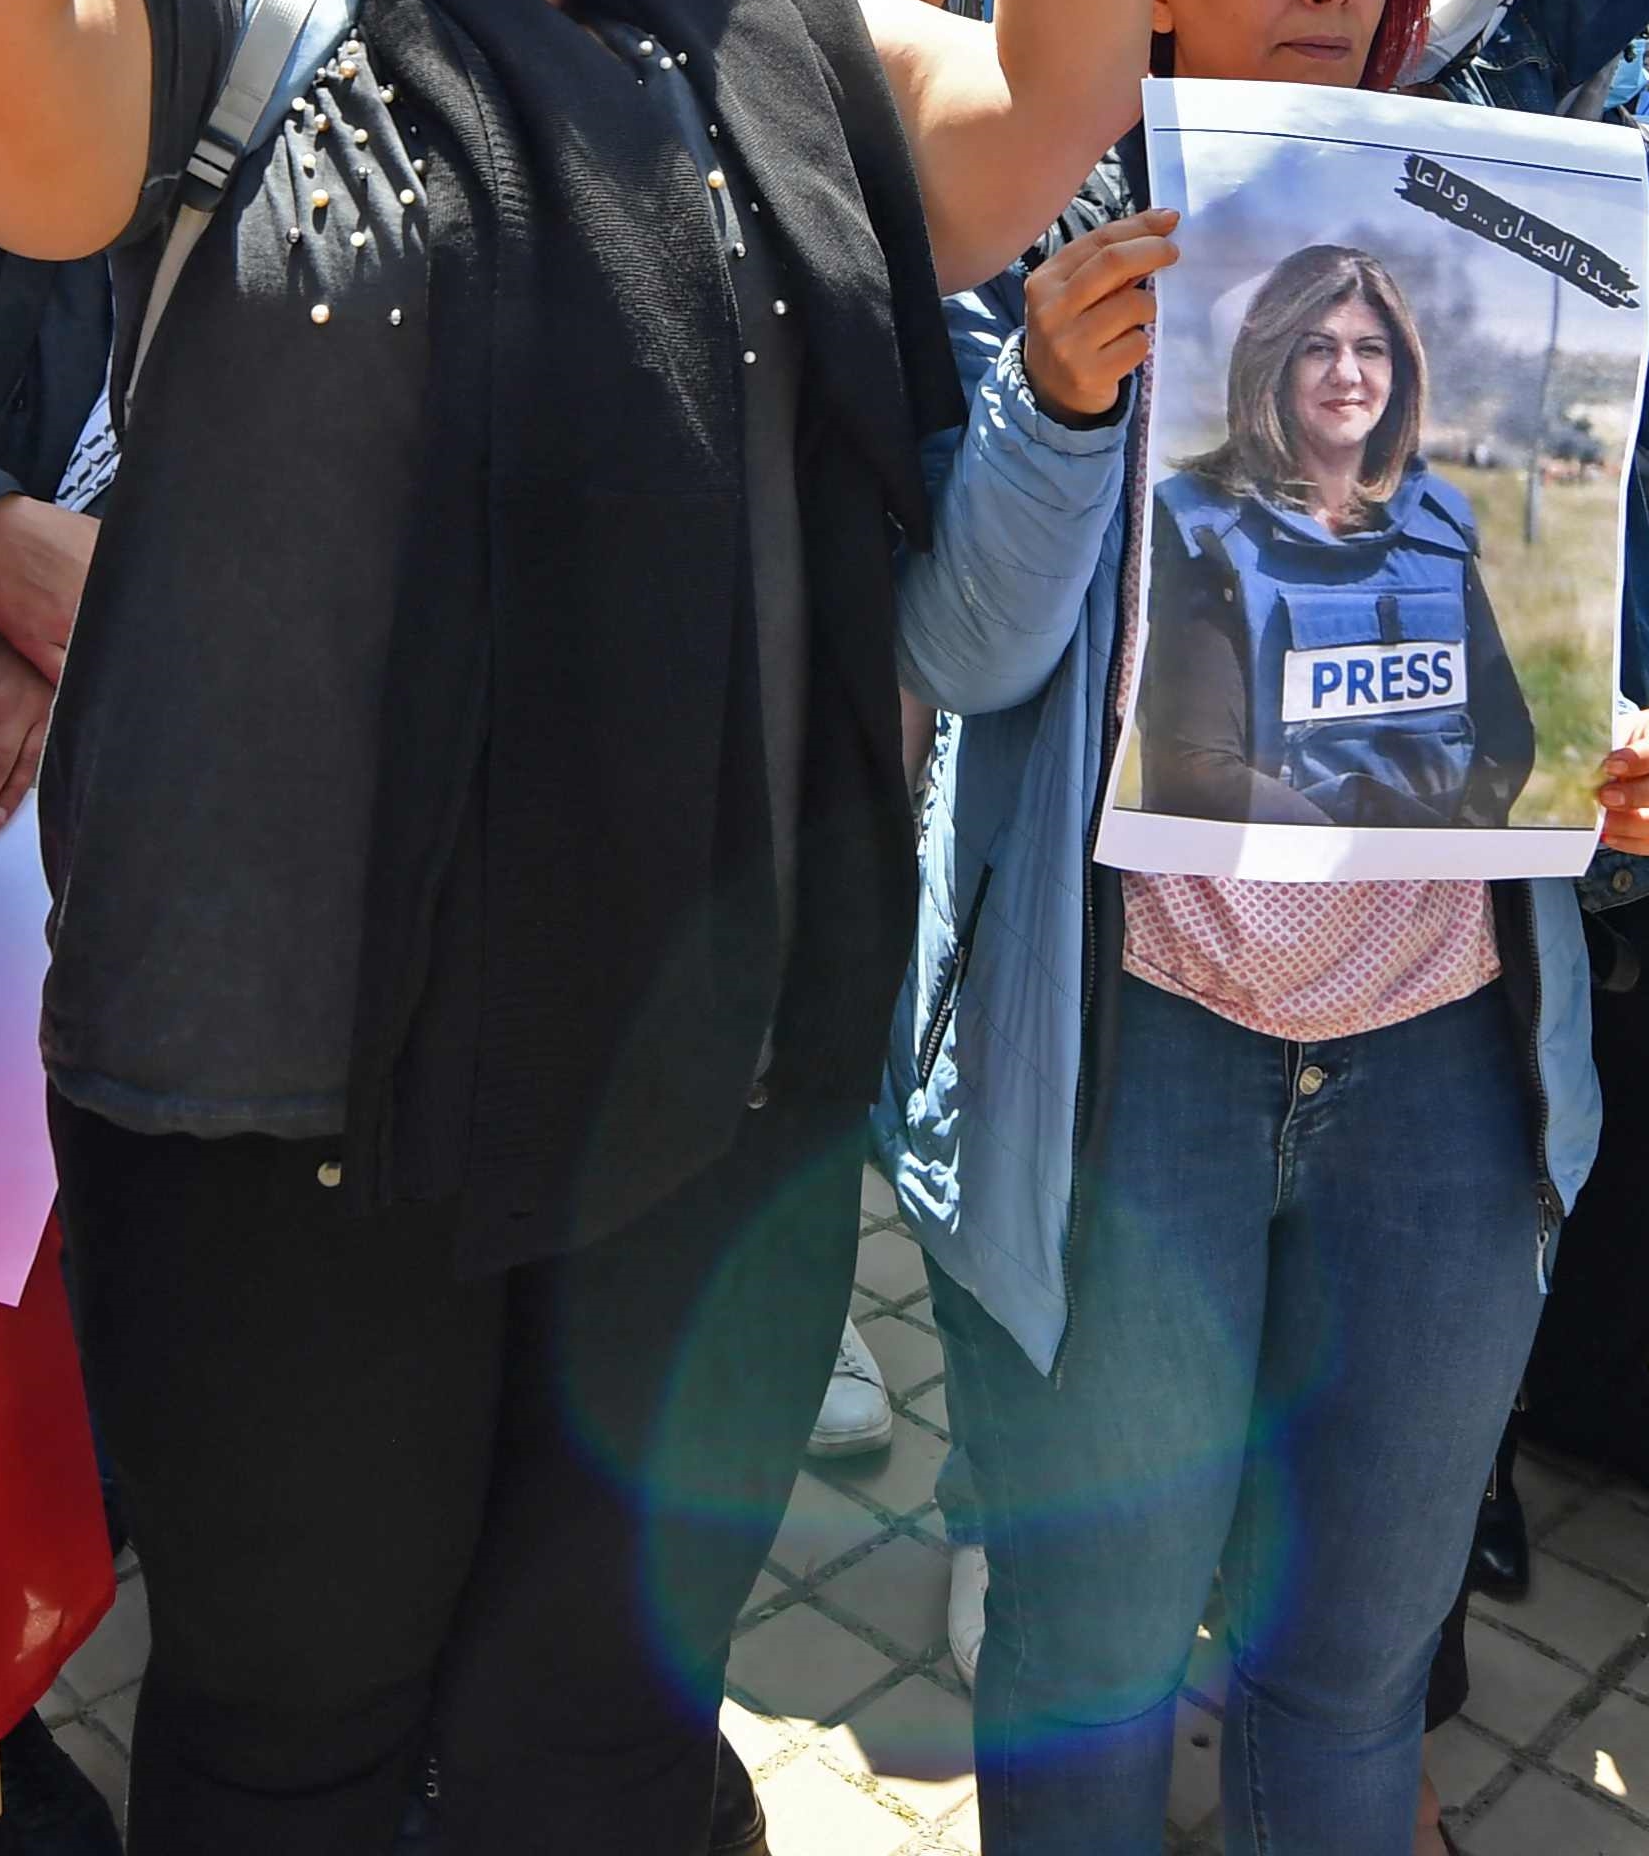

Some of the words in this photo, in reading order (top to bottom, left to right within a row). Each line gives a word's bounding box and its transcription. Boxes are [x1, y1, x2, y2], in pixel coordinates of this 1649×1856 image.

[1414, 158, 1468, 211] وداعا
[1494, 215, 1575, 267] الميدان
[1576, 254, 1631, 304] سيدة
[1311, 650, 1453, 709] PRESS
